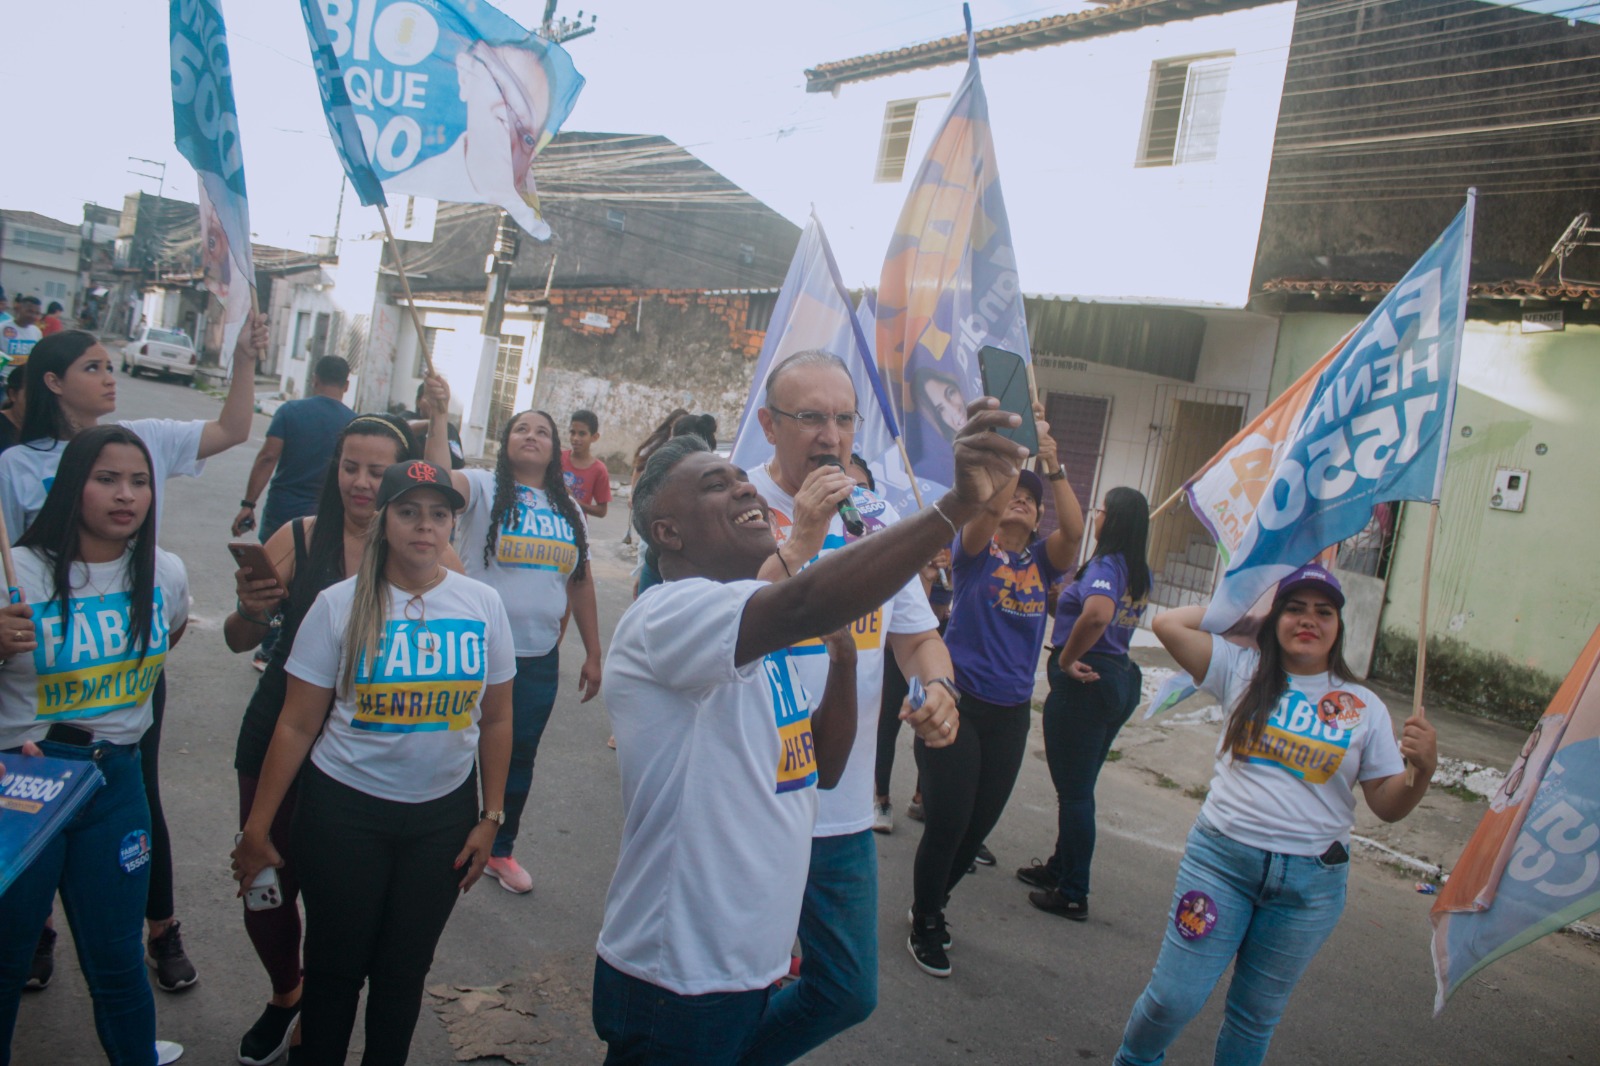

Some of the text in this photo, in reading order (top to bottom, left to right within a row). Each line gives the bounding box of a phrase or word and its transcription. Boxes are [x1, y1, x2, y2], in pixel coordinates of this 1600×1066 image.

[344, 66, 428, 111] QUE
[502, 540, 576, 566] HENRIQUE
[41, 602, 164, 668] FÁBO
[360, 690, 479, 717] HENRIQUE
[1246, 733, 1340, 774] NRIQUE
[5, 774, 65, 802] 15500
[125, 852, 150, 873] 15500
